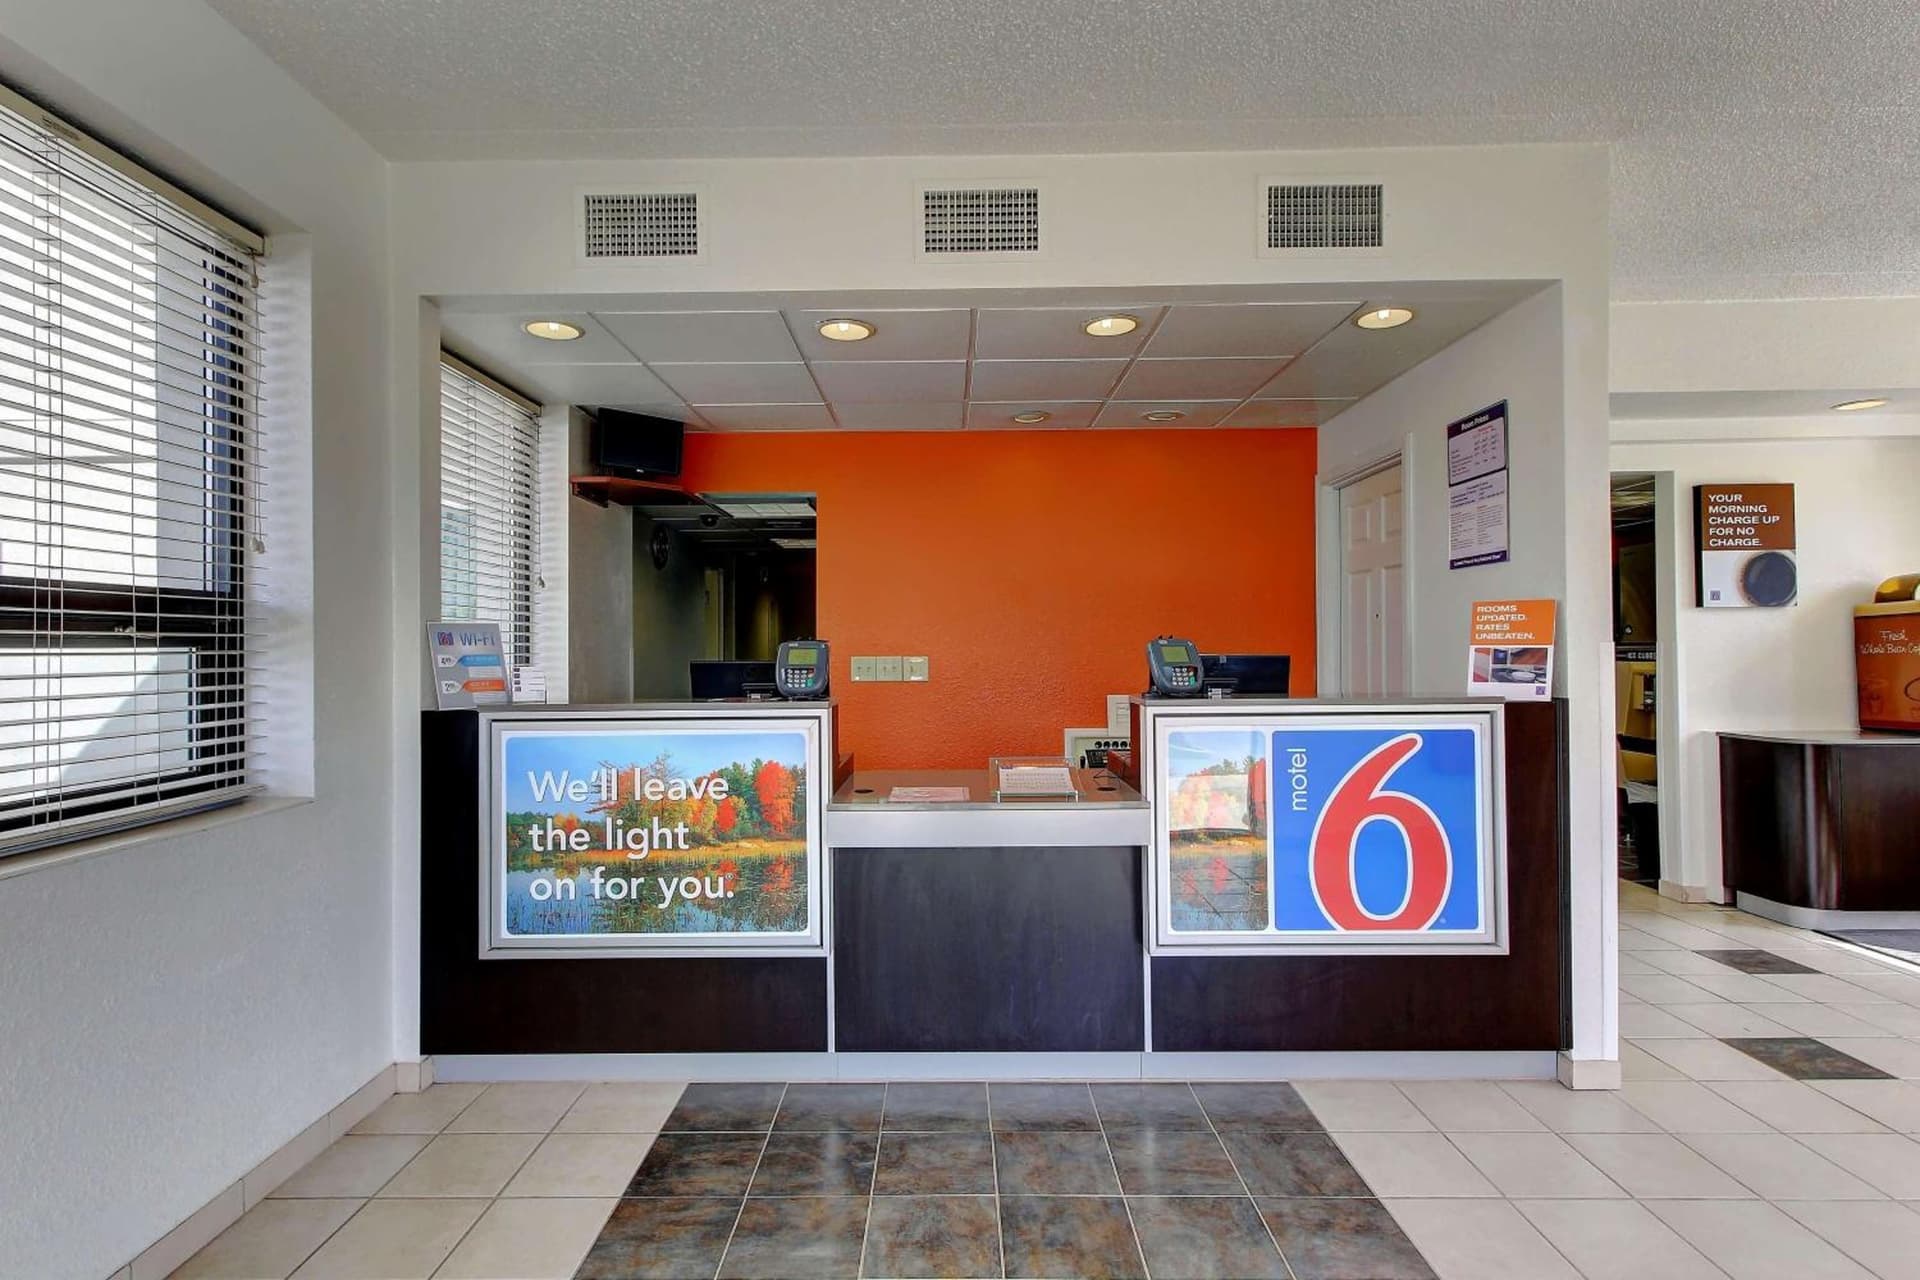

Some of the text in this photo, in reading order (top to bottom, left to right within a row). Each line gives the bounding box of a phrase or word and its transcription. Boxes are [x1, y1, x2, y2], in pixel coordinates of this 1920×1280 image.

[1708, 494, 1743, 502] YOUR
[1708, 504, 1768, 514] MORNING
[1708, 515, 1780, 525] CHARGE UP
[1709, 526, 1755, 536] FOR NO
[1709, 538, 1763, 547] CHARGE.
[1475, 623, 1510, 631] RATES
[1475, 632, 1536, 640] UNBEATEN.
[528, 767, 729, 802] We'll leave
[1286, 747, 1308, 812] motel
[1308, 732, 1453, 932] 6
[529, 816, 690, 860] the light
[529, 876, 577, 901] on
[590, 866, 645, 900] for
